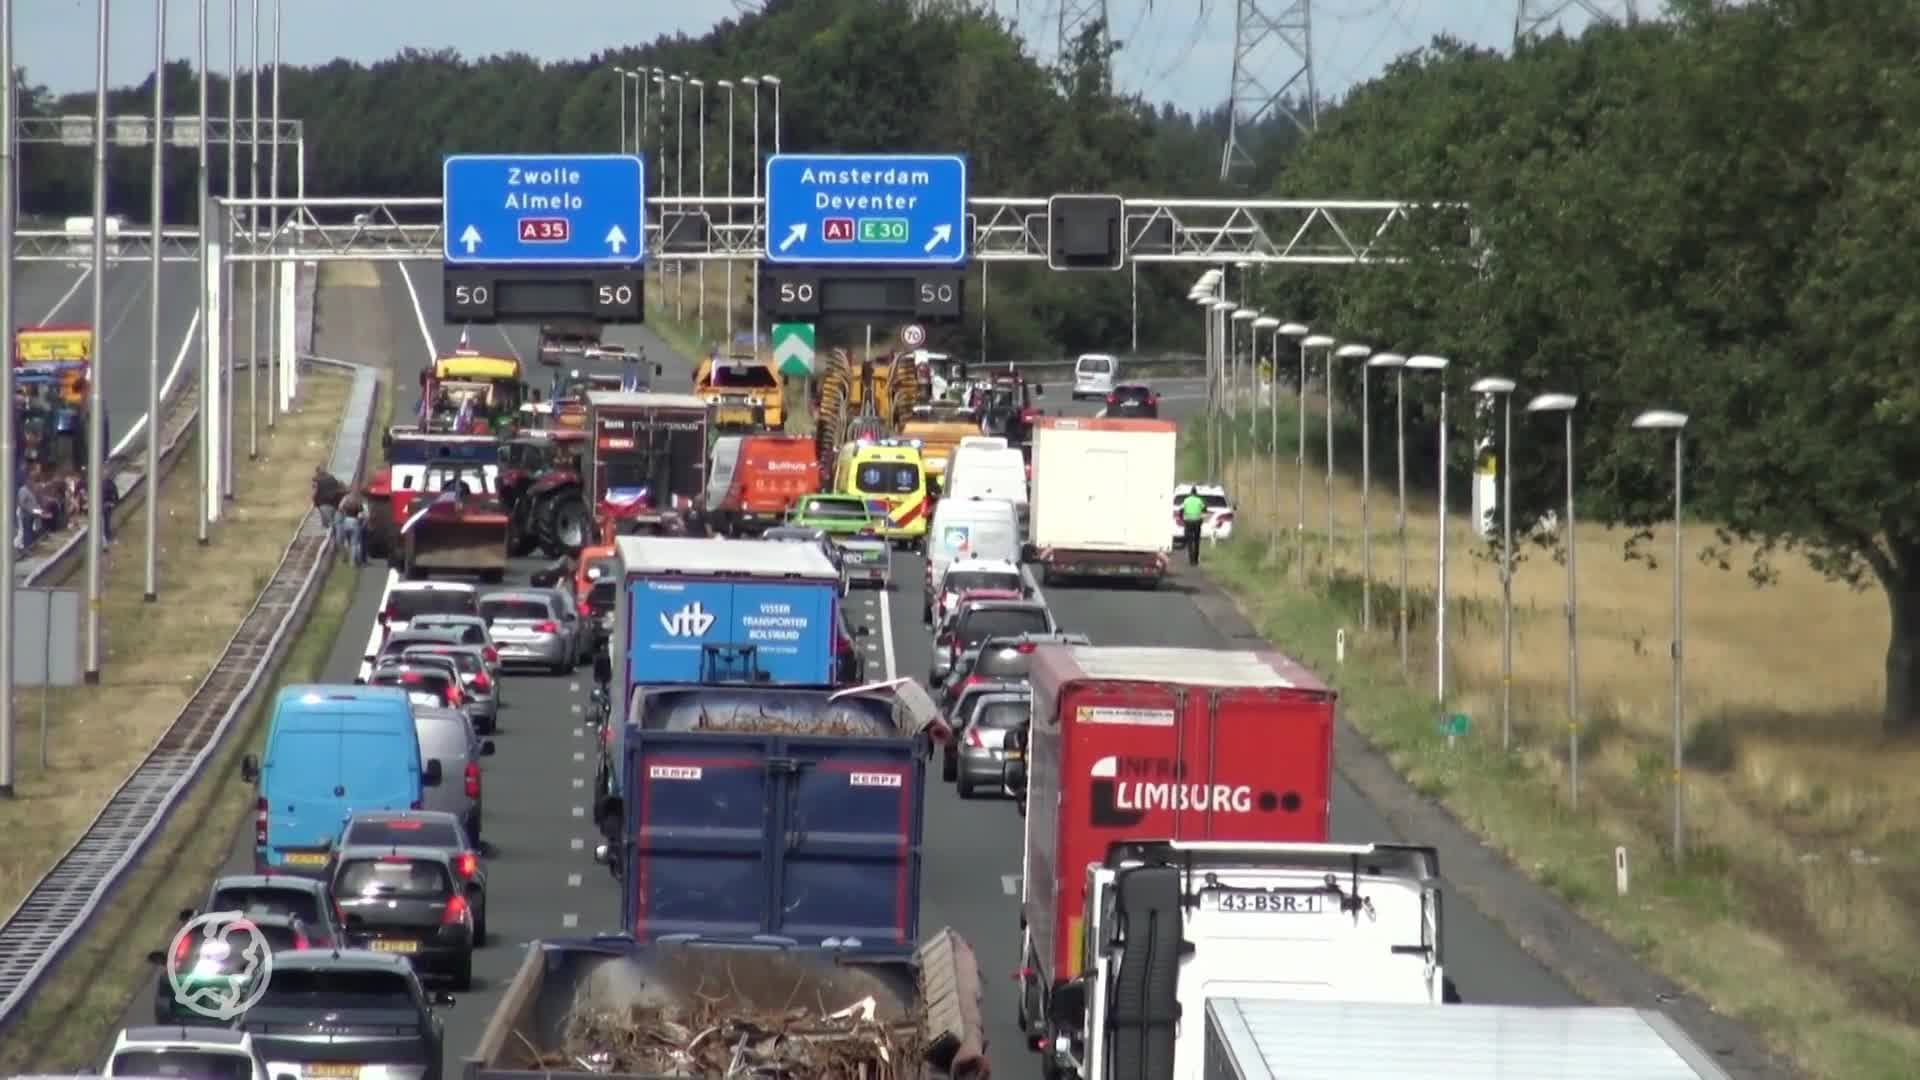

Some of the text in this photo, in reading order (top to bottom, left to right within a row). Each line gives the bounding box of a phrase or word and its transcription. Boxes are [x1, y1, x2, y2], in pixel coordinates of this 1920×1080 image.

[507, 167, 580, 185] Zwolle
[801, 168, 929, 185] Amsterdam
[504, 191, 583, 209] Almelo
[815, 192, 917, 209] Deventer
[455, 285, 488, 305] 50
[599, 285, 632, 305] 50
[780, 283, 813, 303] 50
[920, 284, 953, 303] 50
[905, 329, 921, 341] 70
[760, 602, 791, 614] VISSER
[742, 615, 808, 629] TRANSPORTEN
[852, 774, 898, 785] KEMPF
[1116, 781, 1251, 812] LIMBURG
[1222, 893, 1313, 911] 43-BSR-1
